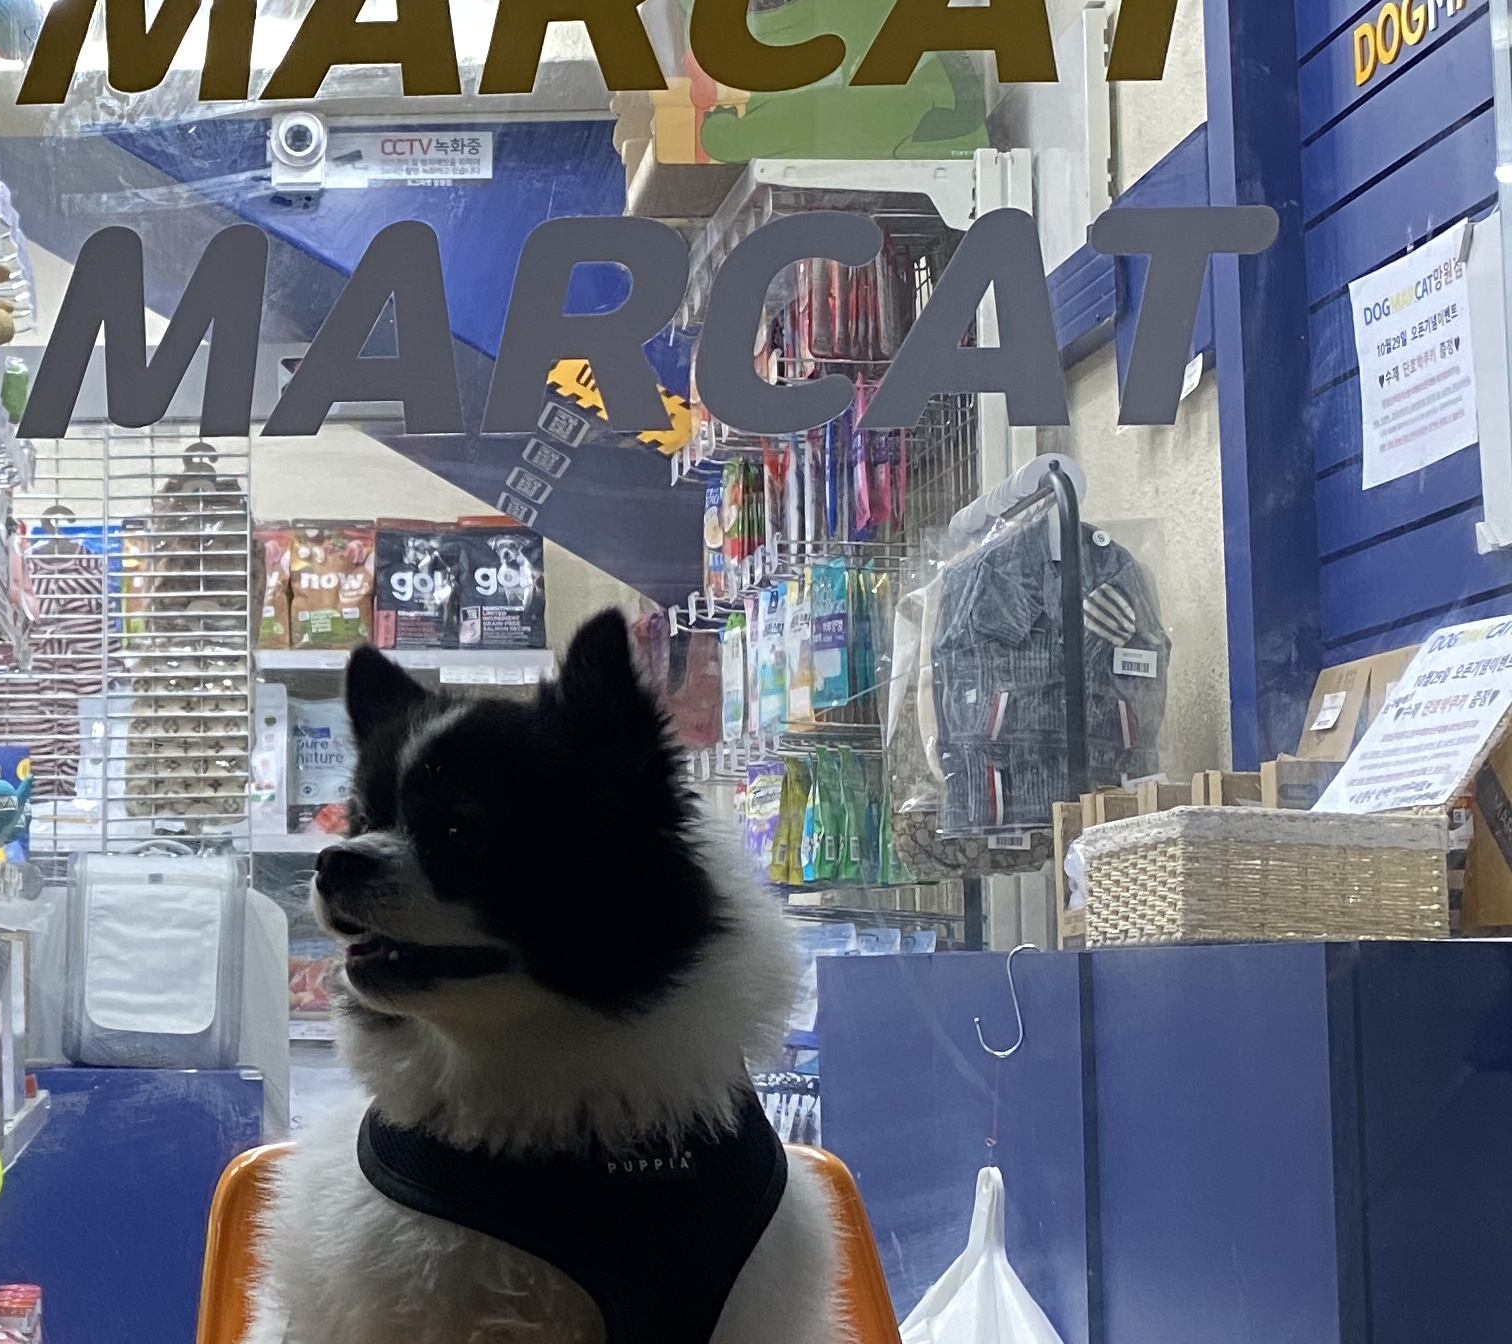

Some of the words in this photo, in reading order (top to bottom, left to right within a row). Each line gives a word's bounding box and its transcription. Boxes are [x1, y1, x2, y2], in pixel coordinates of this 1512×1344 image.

[380, 138, 432, 155] CCTV
[434, 137, 482, 155] 녹화중
[16, 204, 1279, 441] MARCAT
[300, 572, 364, 590] now
[296, 739, 329, 754] pure
[296, 750, 344, 764] nature
[607, 1156, 690, 1174] PUPPIA
